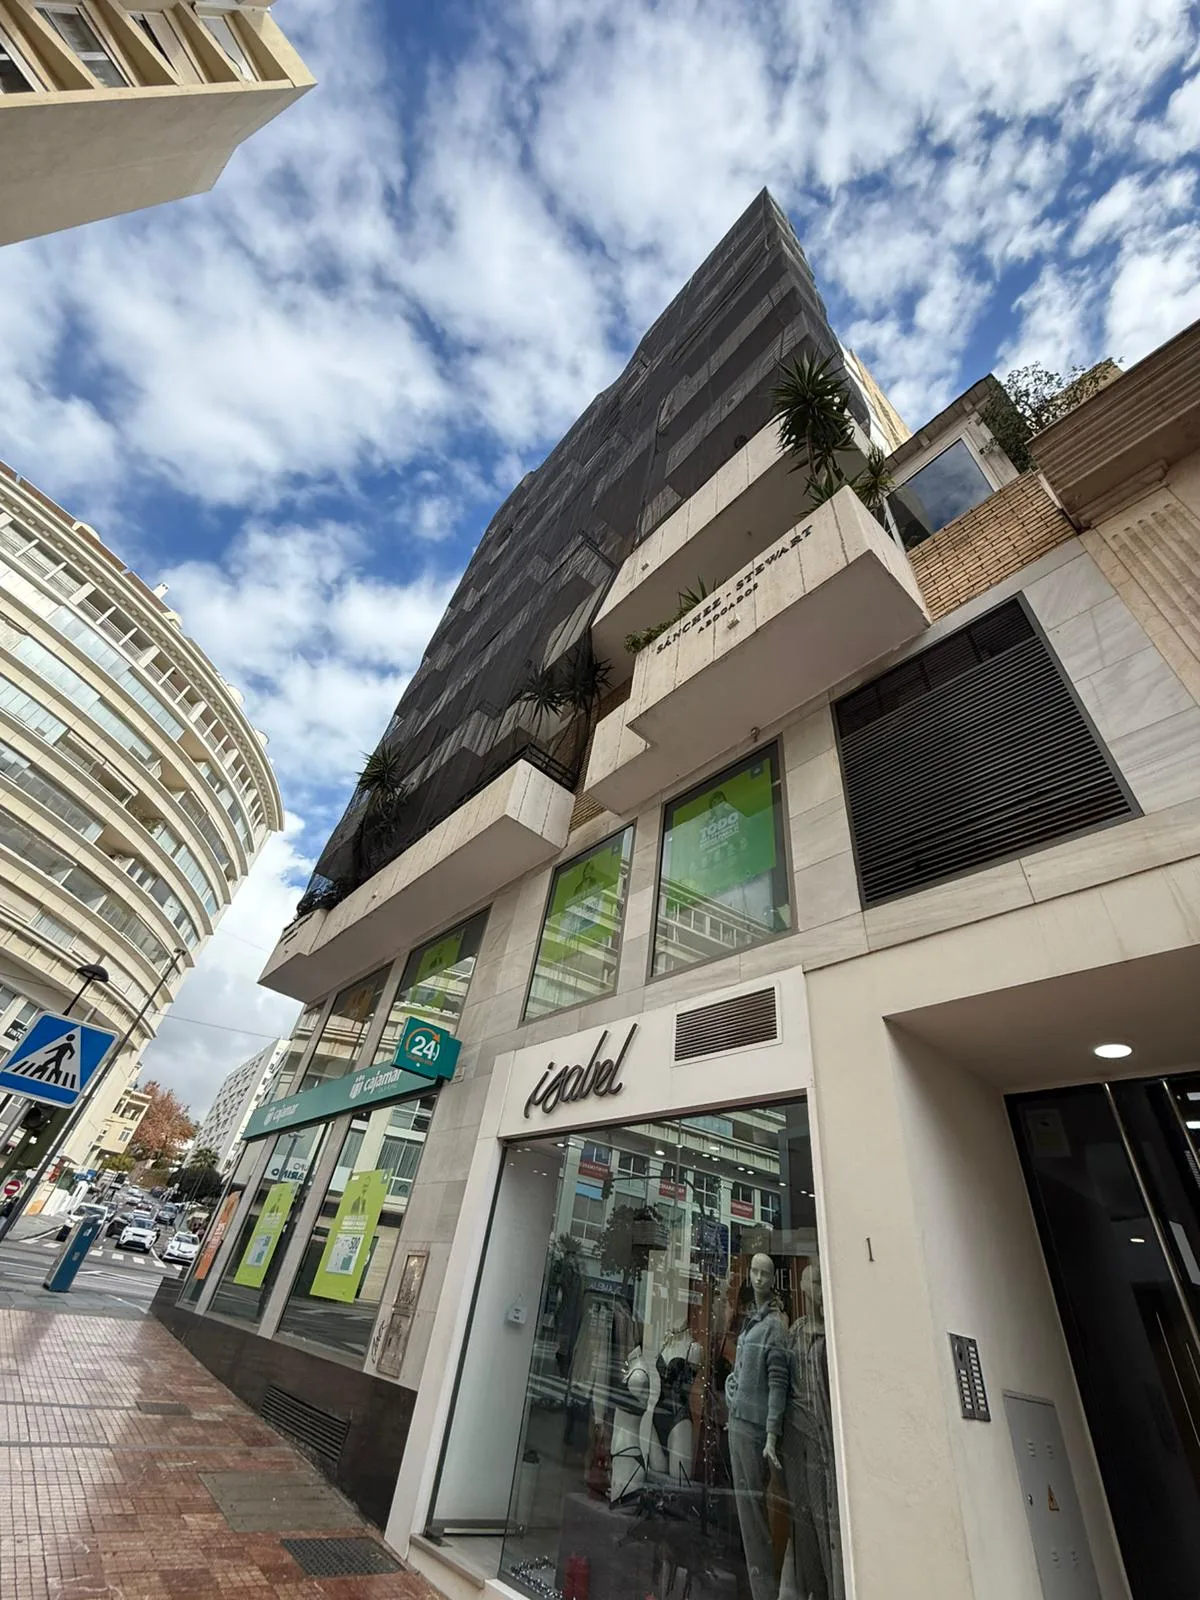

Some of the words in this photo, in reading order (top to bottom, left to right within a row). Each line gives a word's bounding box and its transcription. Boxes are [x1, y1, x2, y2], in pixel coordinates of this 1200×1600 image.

[656, 597, 722, 655] SÁNCHEZ
[735, 524, 813, 592] STEWART
[697, 582, 759, 634] ABOGADOS
[363, 1069, 403, 1095] cajamar
